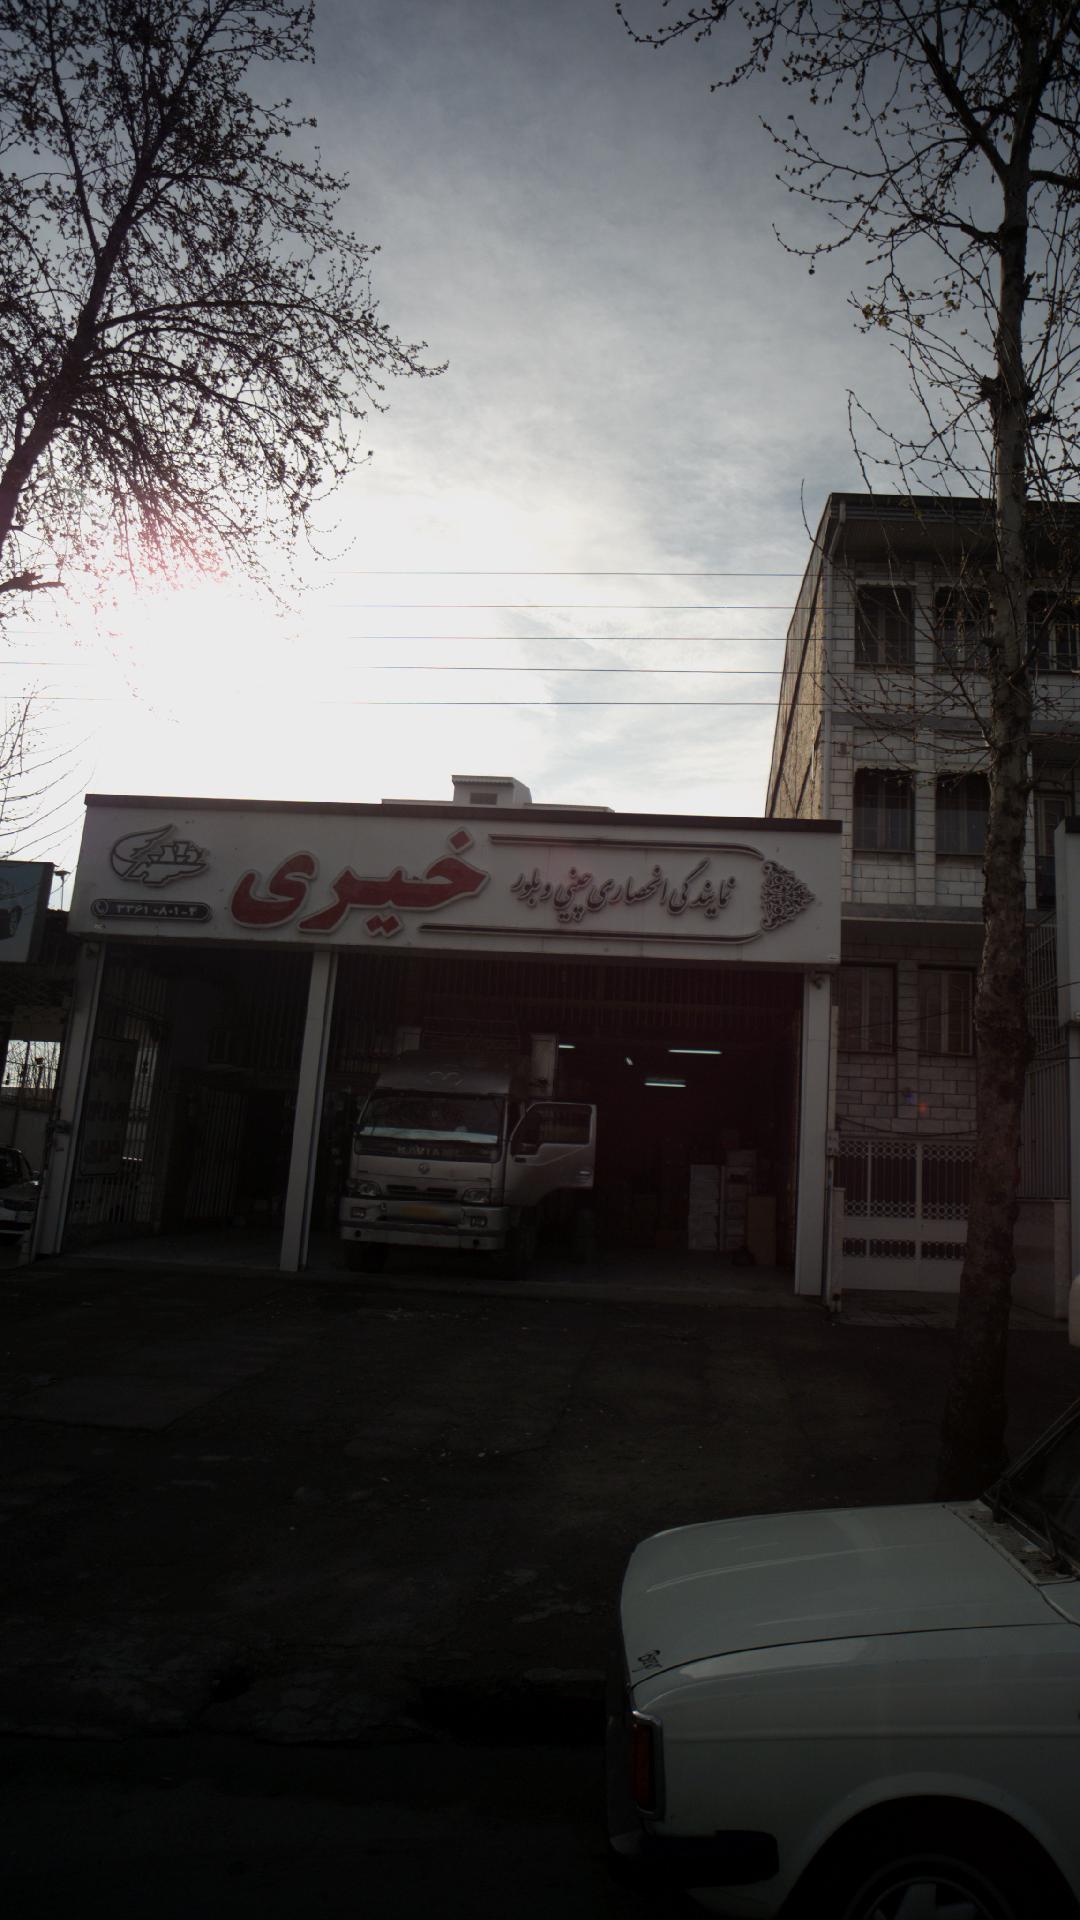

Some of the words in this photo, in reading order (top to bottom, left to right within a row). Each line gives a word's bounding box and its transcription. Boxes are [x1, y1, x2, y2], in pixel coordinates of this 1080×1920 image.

[231, 826, 489, 938] خیری
[510, 868, 541, 907] بلور
[540, 881, 552, 900] و
[554, 866, 593, 921] چینی
[586, 864, 668, 912] انحصاری
[667, 857, 737, 918] نمایندگی
